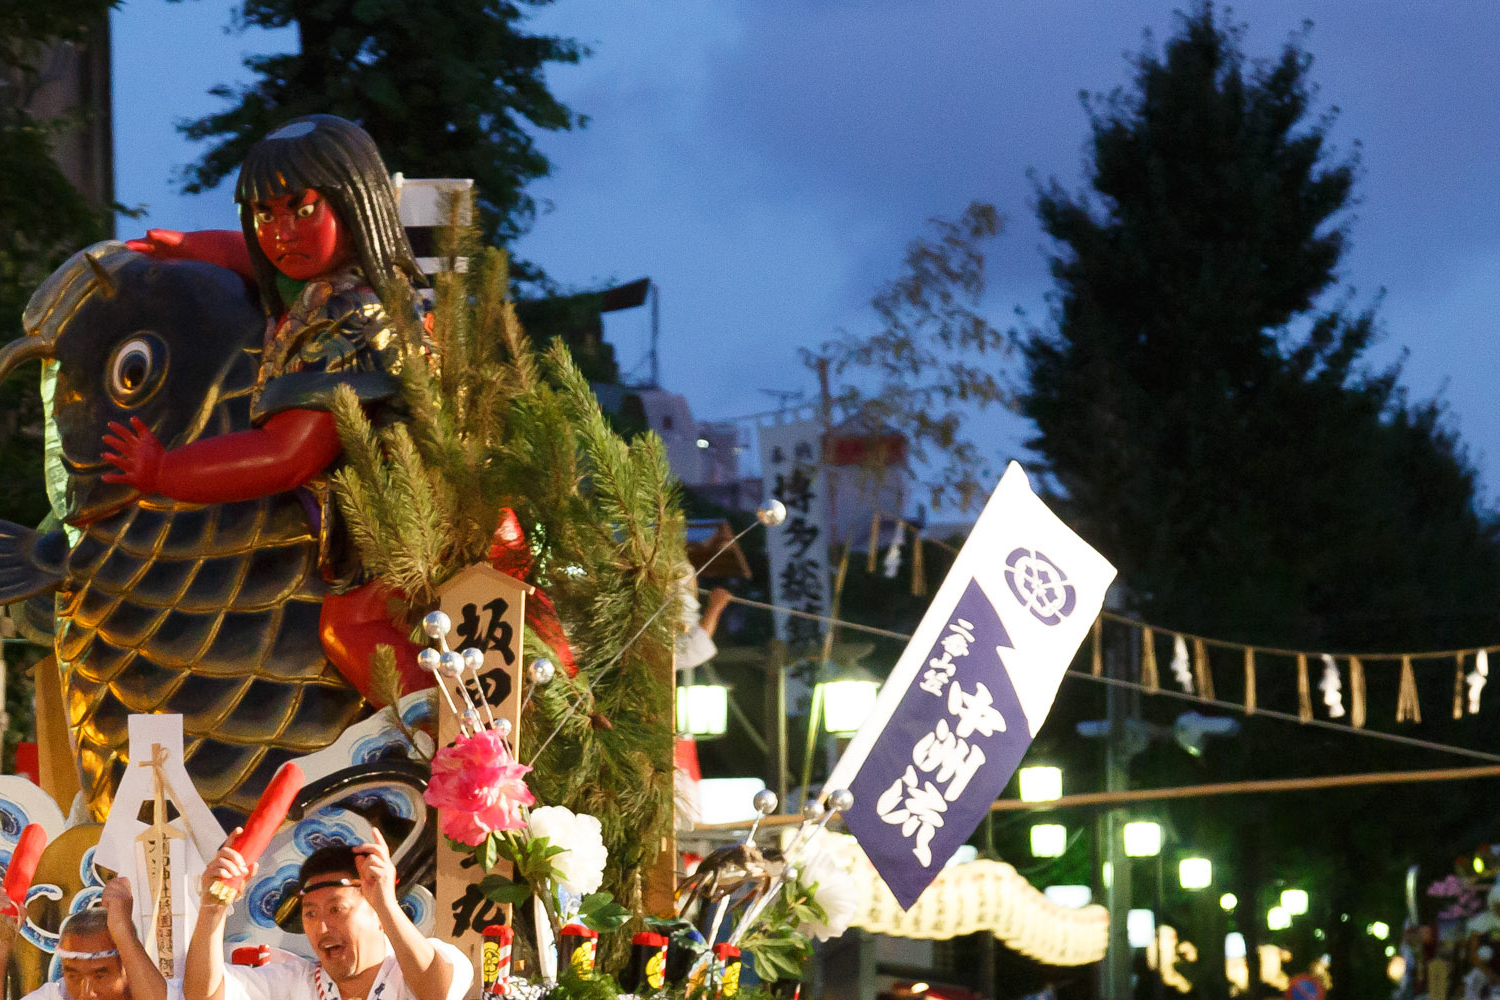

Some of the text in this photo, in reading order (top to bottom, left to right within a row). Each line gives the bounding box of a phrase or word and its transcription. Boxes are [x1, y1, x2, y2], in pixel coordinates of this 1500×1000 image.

[919, 618, 976, 698] 二番山笠
[451, 598, 516, 938] 坂田丸
[876, 680, 1007, 868] 中洲流
